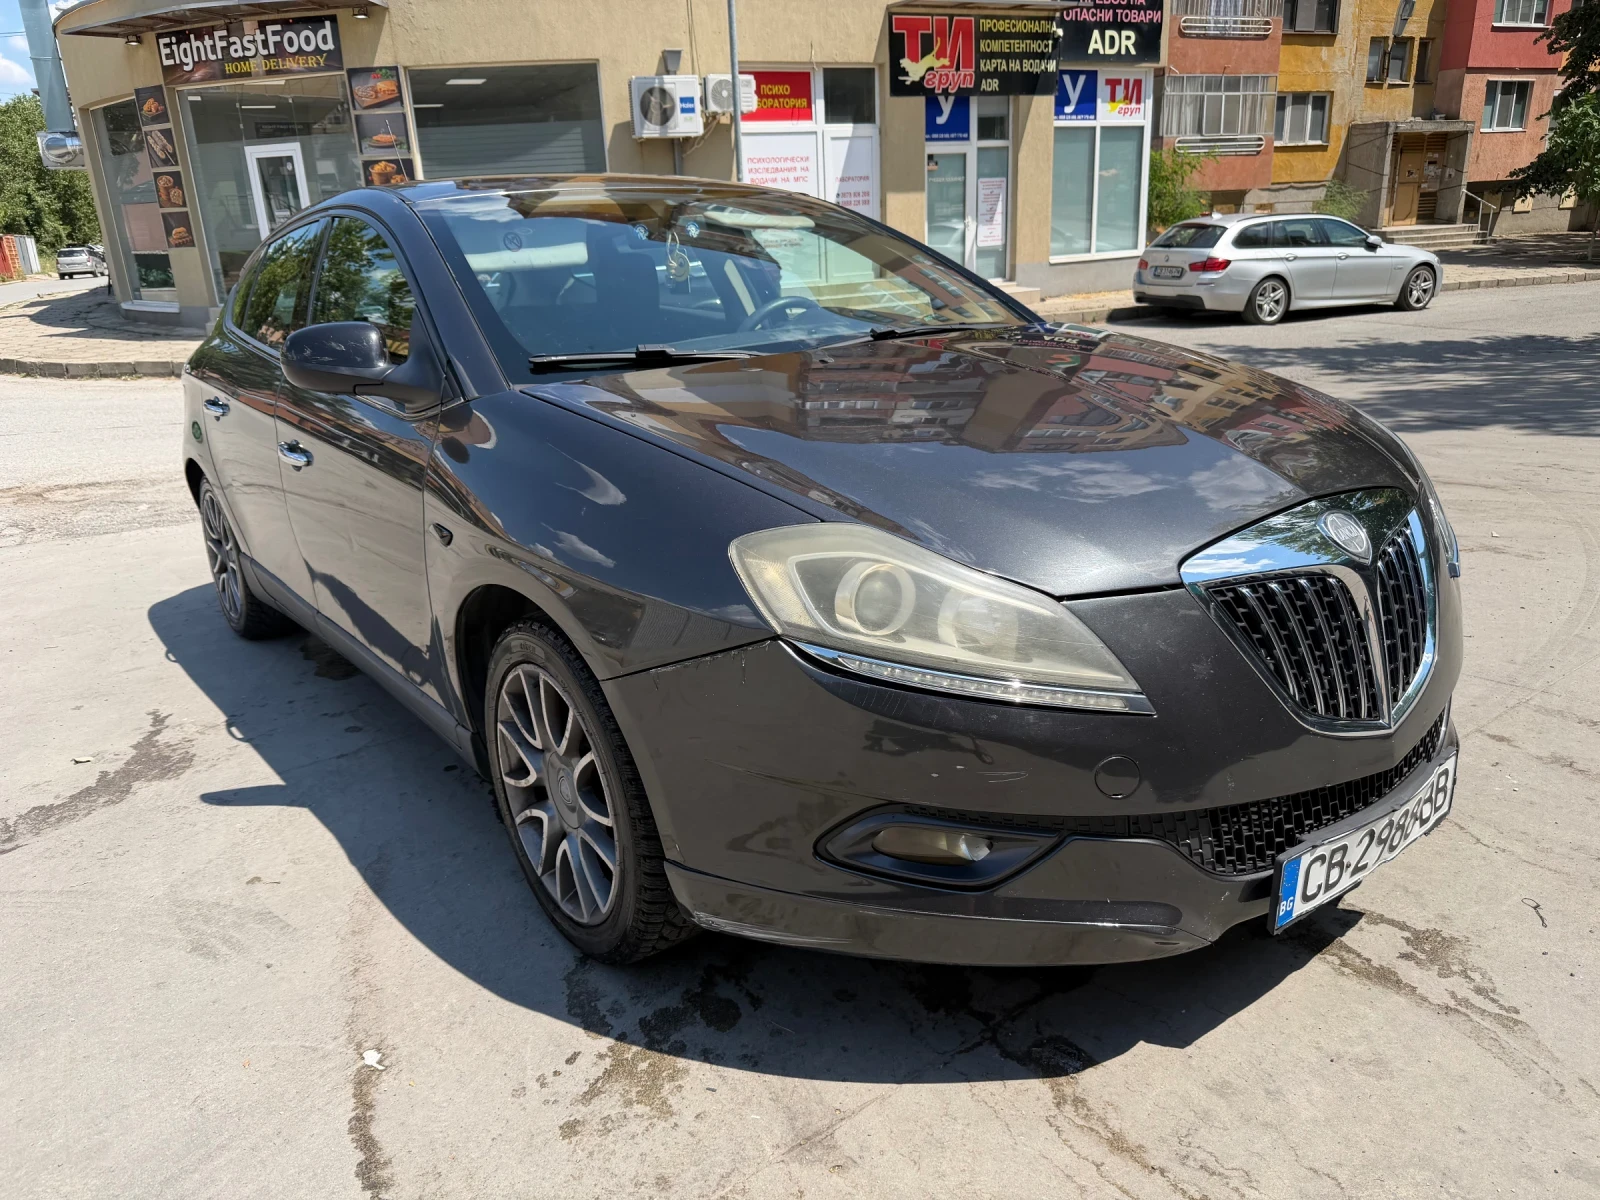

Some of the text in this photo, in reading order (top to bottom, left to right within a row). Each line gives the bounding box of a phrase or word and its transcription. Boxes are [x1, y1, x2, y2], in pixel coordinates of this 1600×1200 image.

[1063, 8, 1161, 23] ОПАСНИ ТОВАРИ
[979, 18, 1057, 33] ПРОФЕСИОНАЛНА
[158, 21, 335, 71] EightFastFood
[892, 15, 975, 71] ТИ
[1088, 29, 1137, 55] ADR
[224, 53, 327, 74] HOME DELIVERY
[980, 59, 1057, 74] КАРТА НА ВОДАЧИ
[924, 70, 975, 93] груп
[980, 79, 999, 91] ADR
[760, 84, 791, 95] ПСИХО
[1105, 78, 1142, 105] ТИ
[756, 98, 808, 109] БОРАТОРИЯ
[1117, 106, 1140, 116] груп
[780, 176, 790, 184] НА
[1279, 896, 1294, 916] BG
